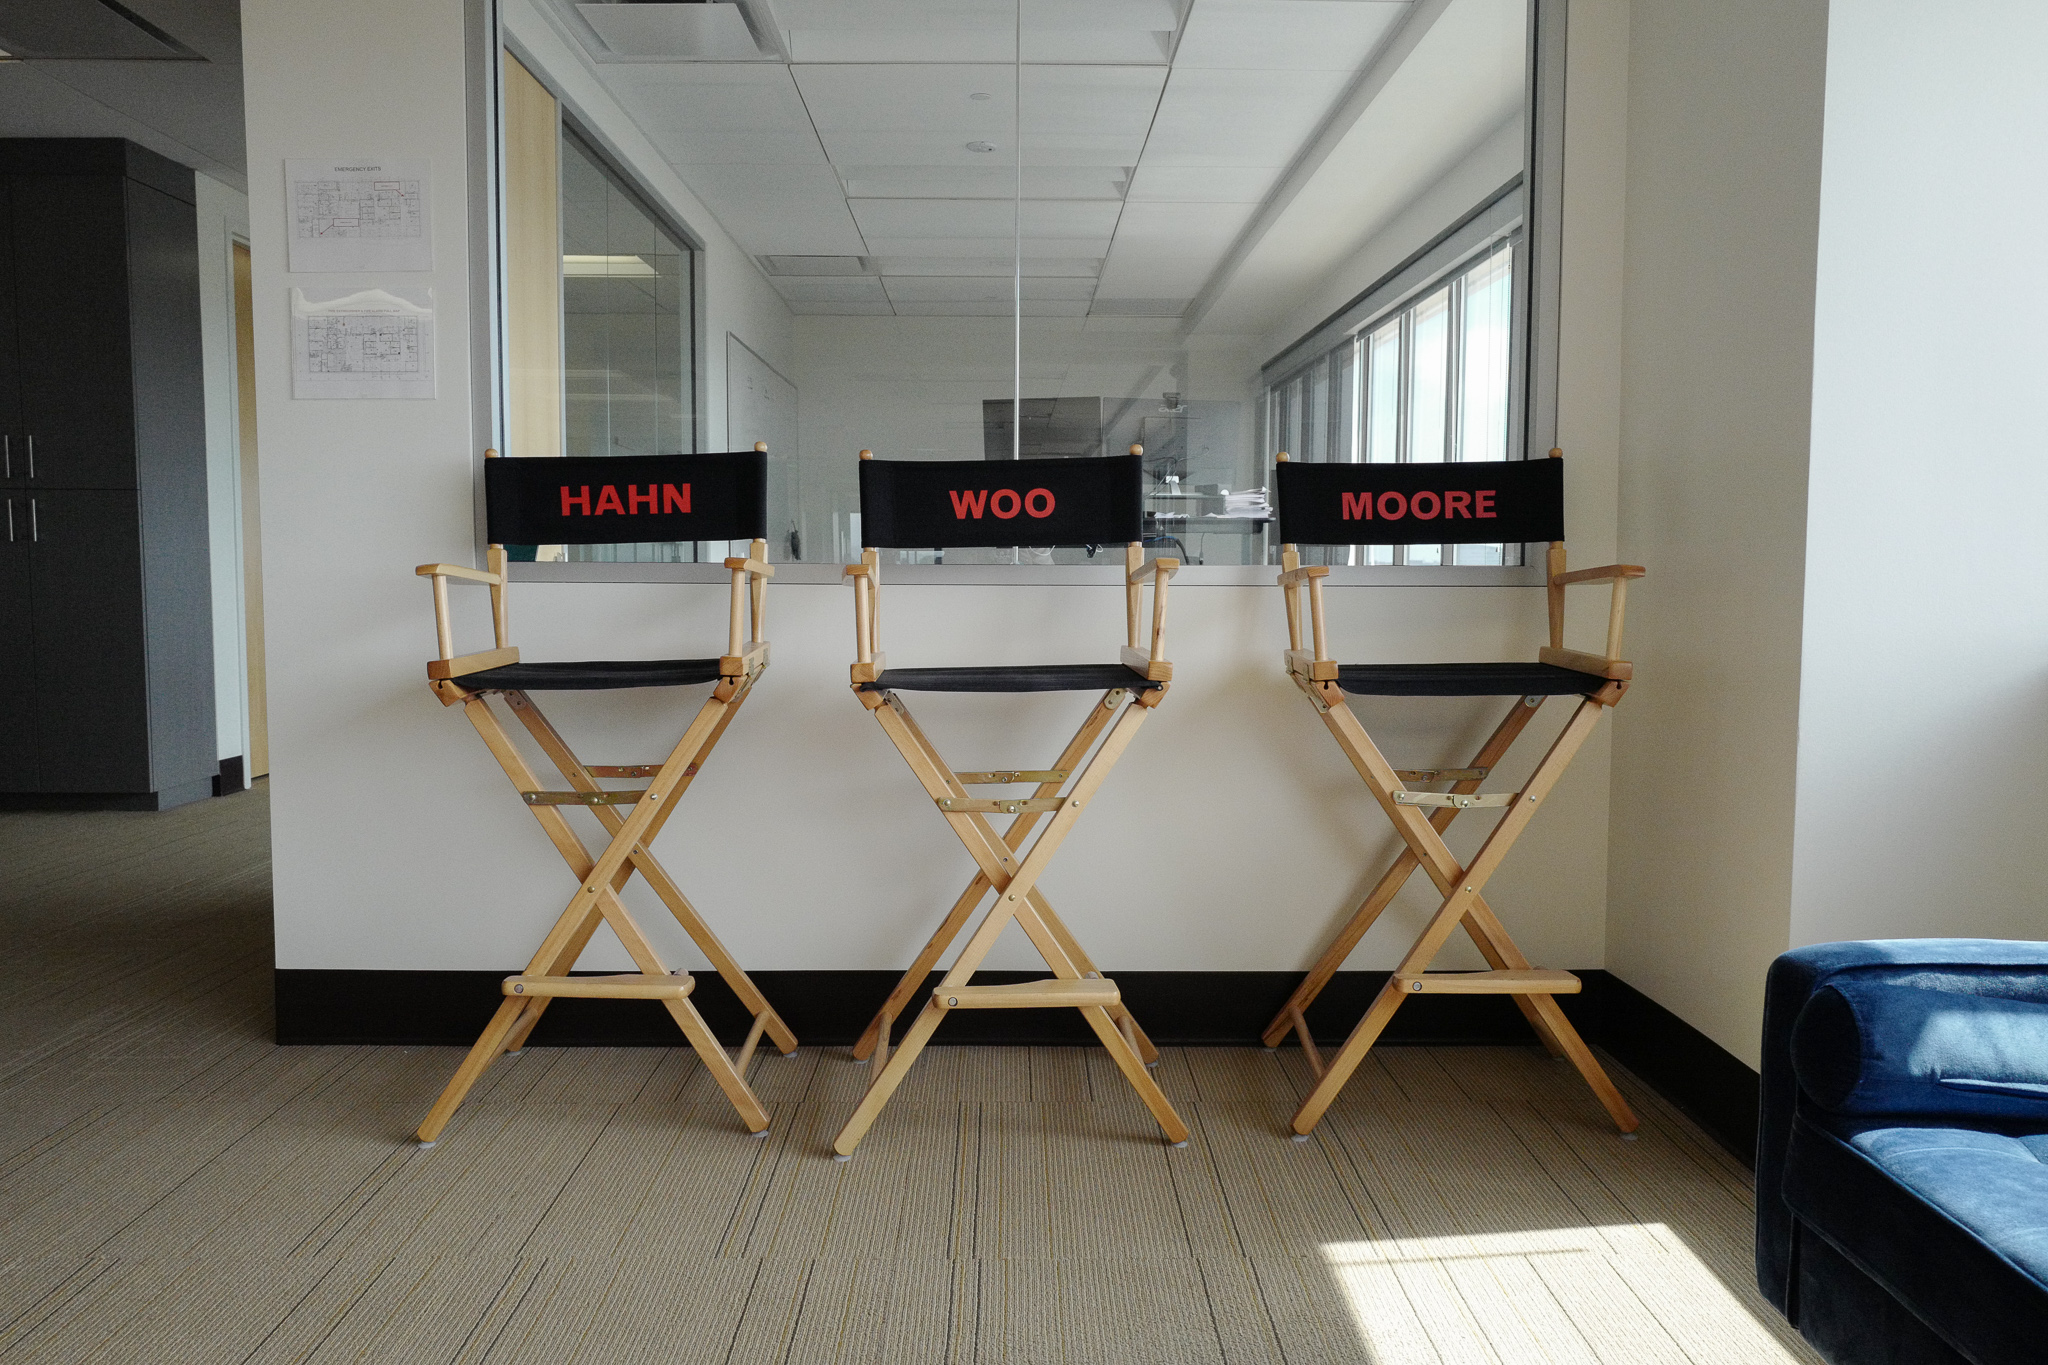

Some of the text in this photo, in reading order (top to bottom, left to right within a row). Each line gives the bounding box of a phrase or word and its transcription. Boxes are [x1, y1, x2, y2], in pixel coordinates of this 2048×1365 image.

[560, 482, 692, 517] HAHN
[949, 487, 1056, 520] WOO
[1341, 490, 1497, 521] MOORE
